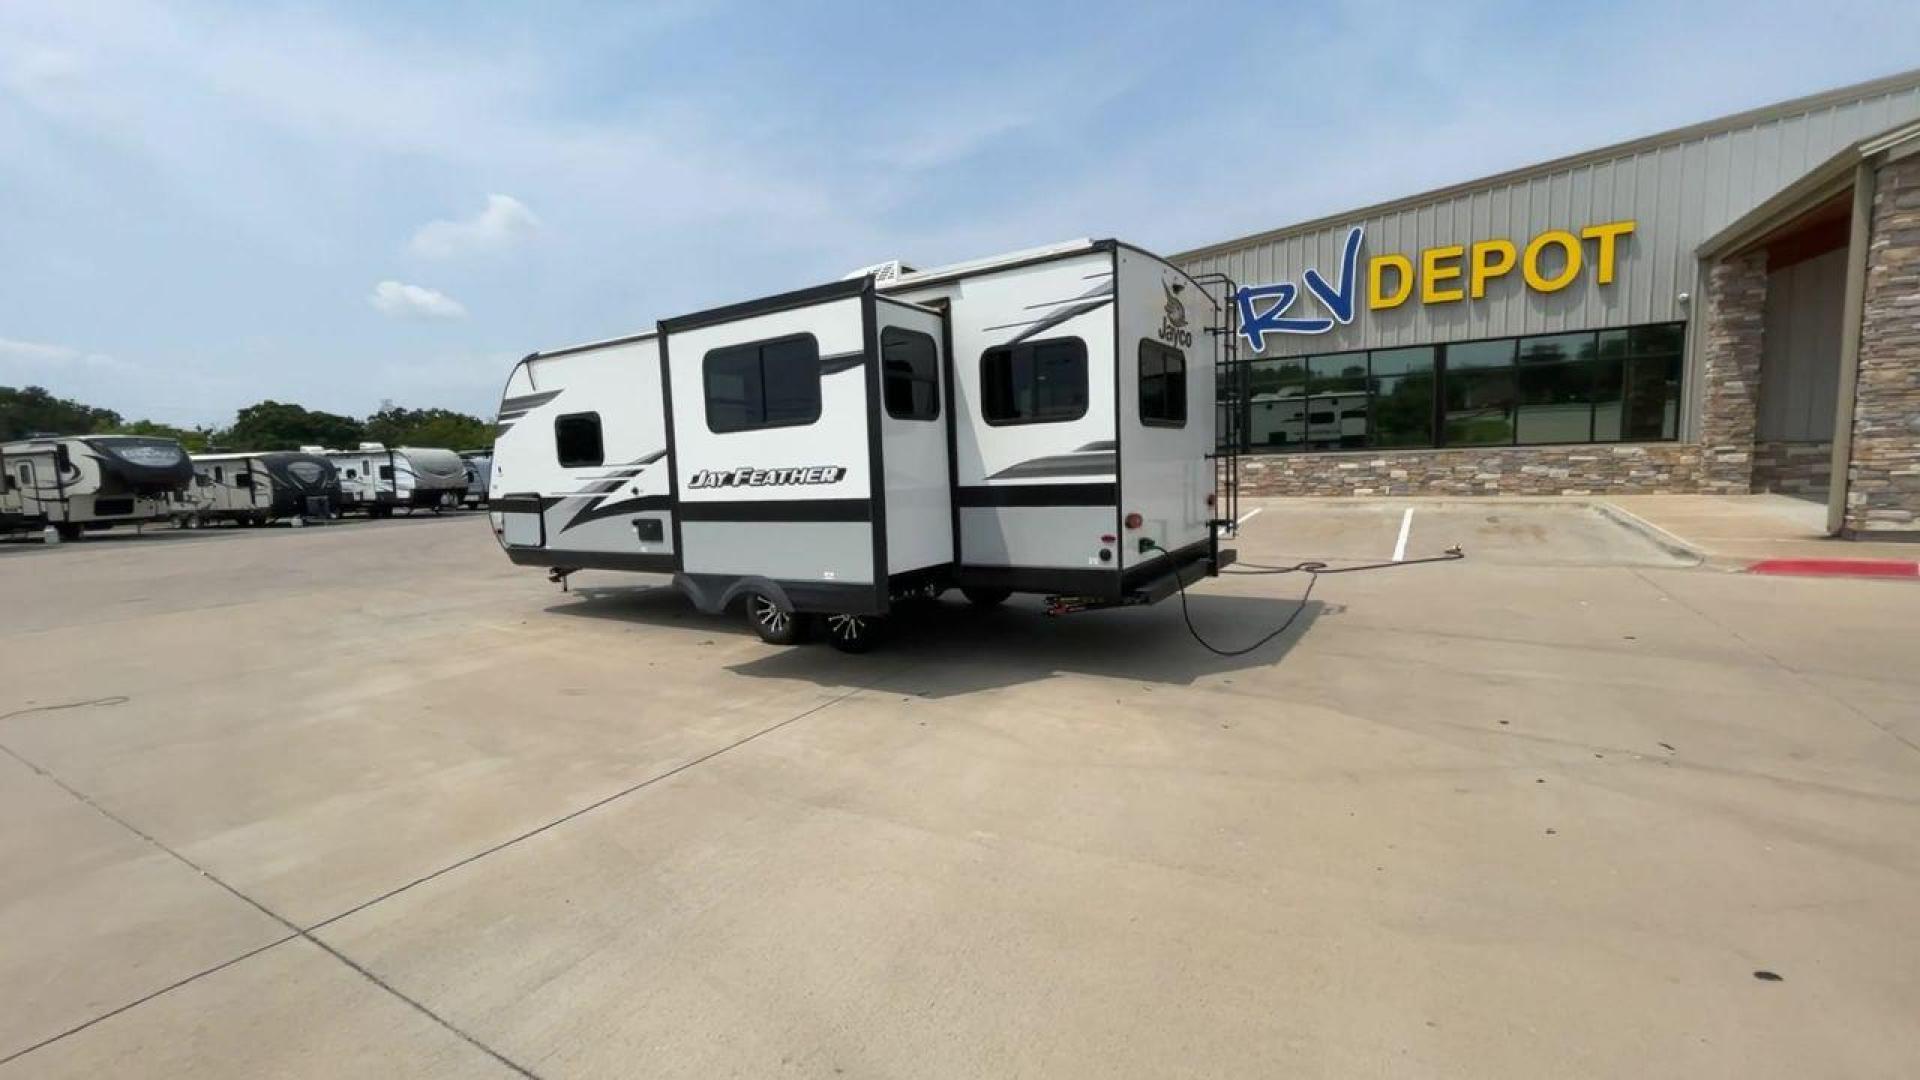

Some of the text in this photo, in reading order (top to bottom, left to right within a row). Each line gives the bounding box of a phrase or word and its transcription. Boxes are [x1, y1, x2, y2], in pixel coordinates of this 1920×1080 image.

[1238, 221, 1637, 352] RV DEPOT
[1158, 316, 1192, 348] Jayco
[688, 465, 838, 489] JAY FEATHER
